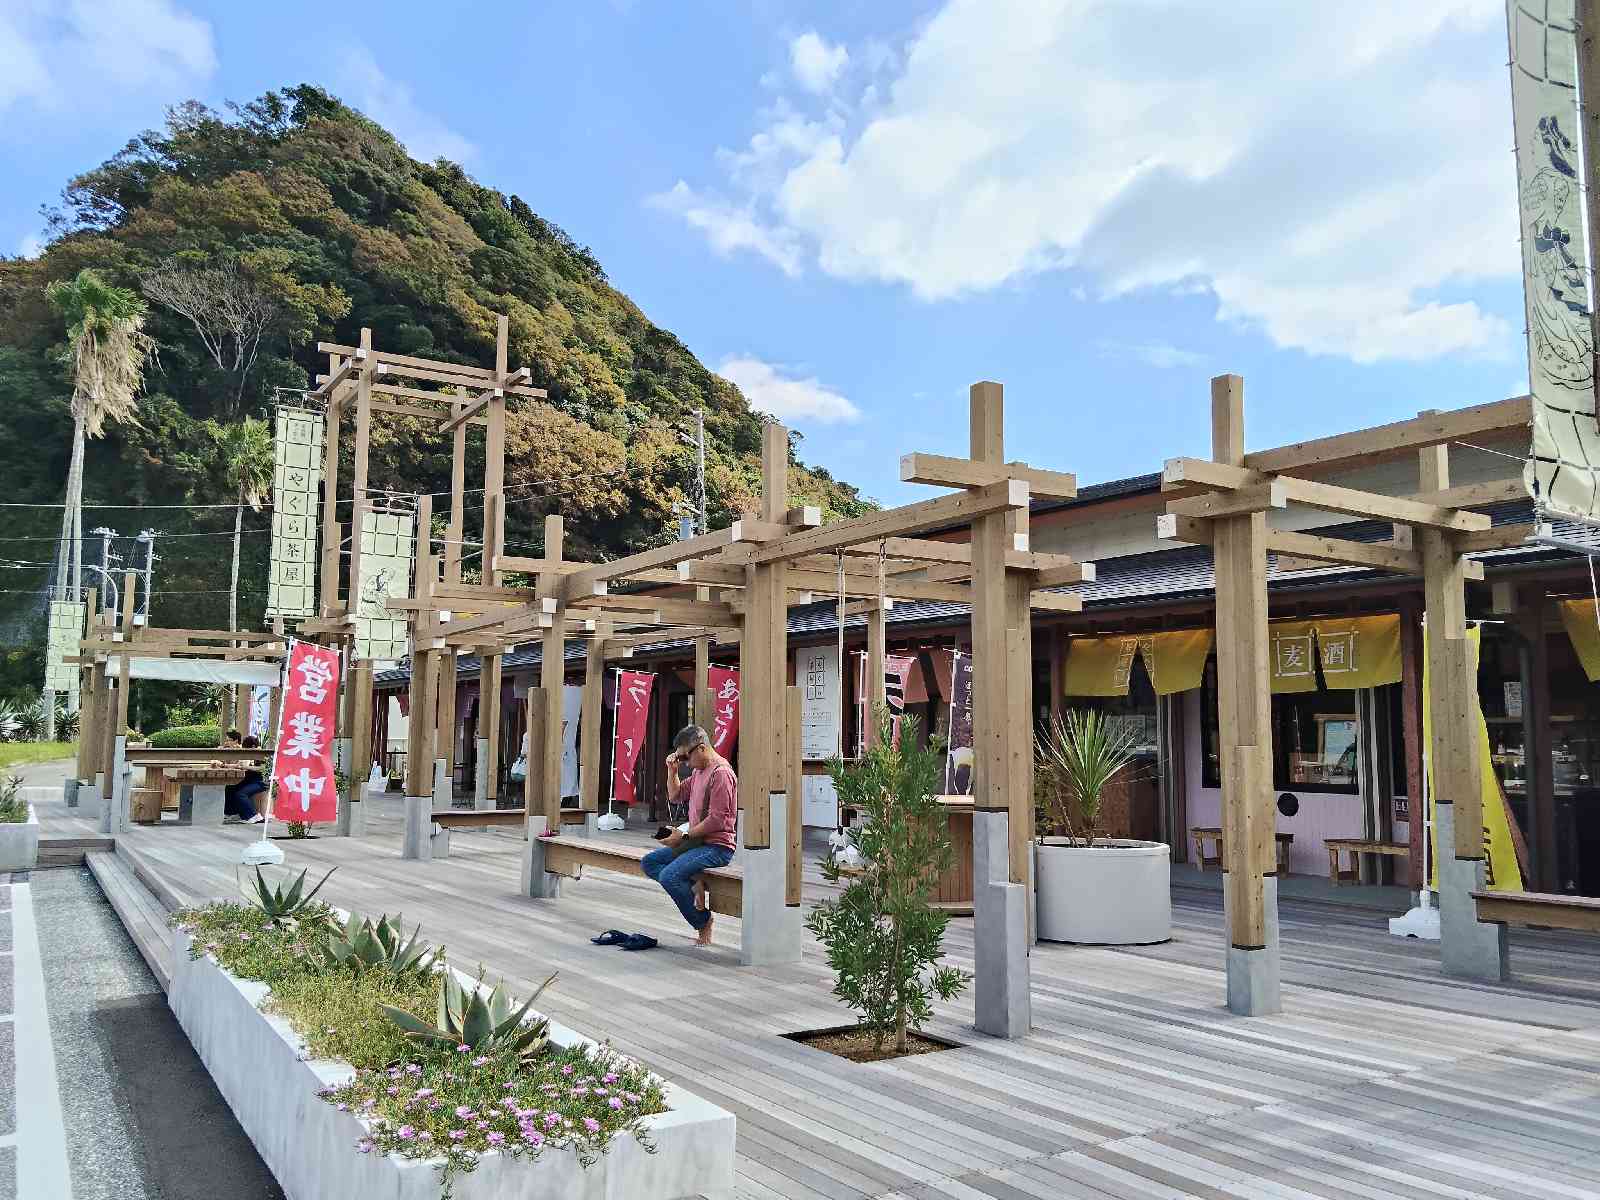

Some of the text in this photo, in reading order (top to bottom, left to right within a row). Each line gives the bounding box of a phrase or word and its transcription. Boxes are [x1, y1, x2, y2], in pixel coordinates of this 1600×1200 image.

[284, 471, 304, 581] やぐら茶屋
[1282, 641, 1345, 668] 麦酒
[282, 654, 333, 813] 営業中
